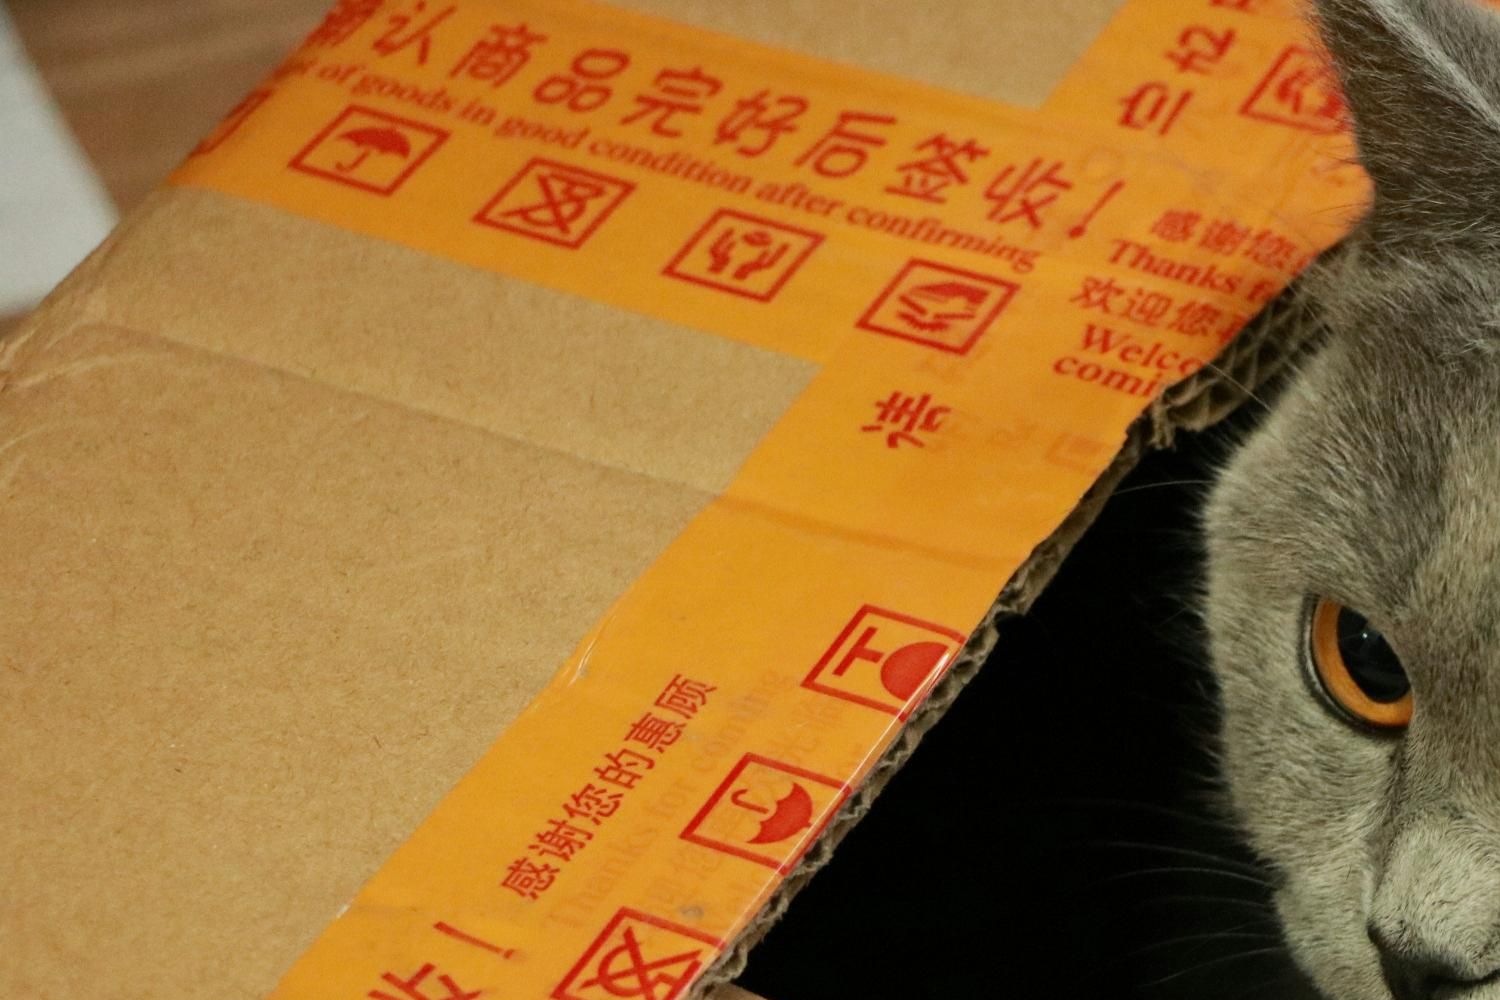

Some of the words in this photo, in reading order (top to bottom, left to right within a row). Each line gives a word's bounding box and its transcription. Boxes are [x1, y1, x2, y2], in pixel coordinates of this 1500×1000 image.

[350, 75, 455, 112] goods
[458, 97, 497, 126] in
[495, 115, 594, 150] good
[587, 140, 754, 194] condition
[755, 183, 845, 217] after
[847, 206, 1043, 275] confirming
[1109, 238, 1243, 295] Thanks
[499, 673, 718, 900] 感谢您的惠顾
